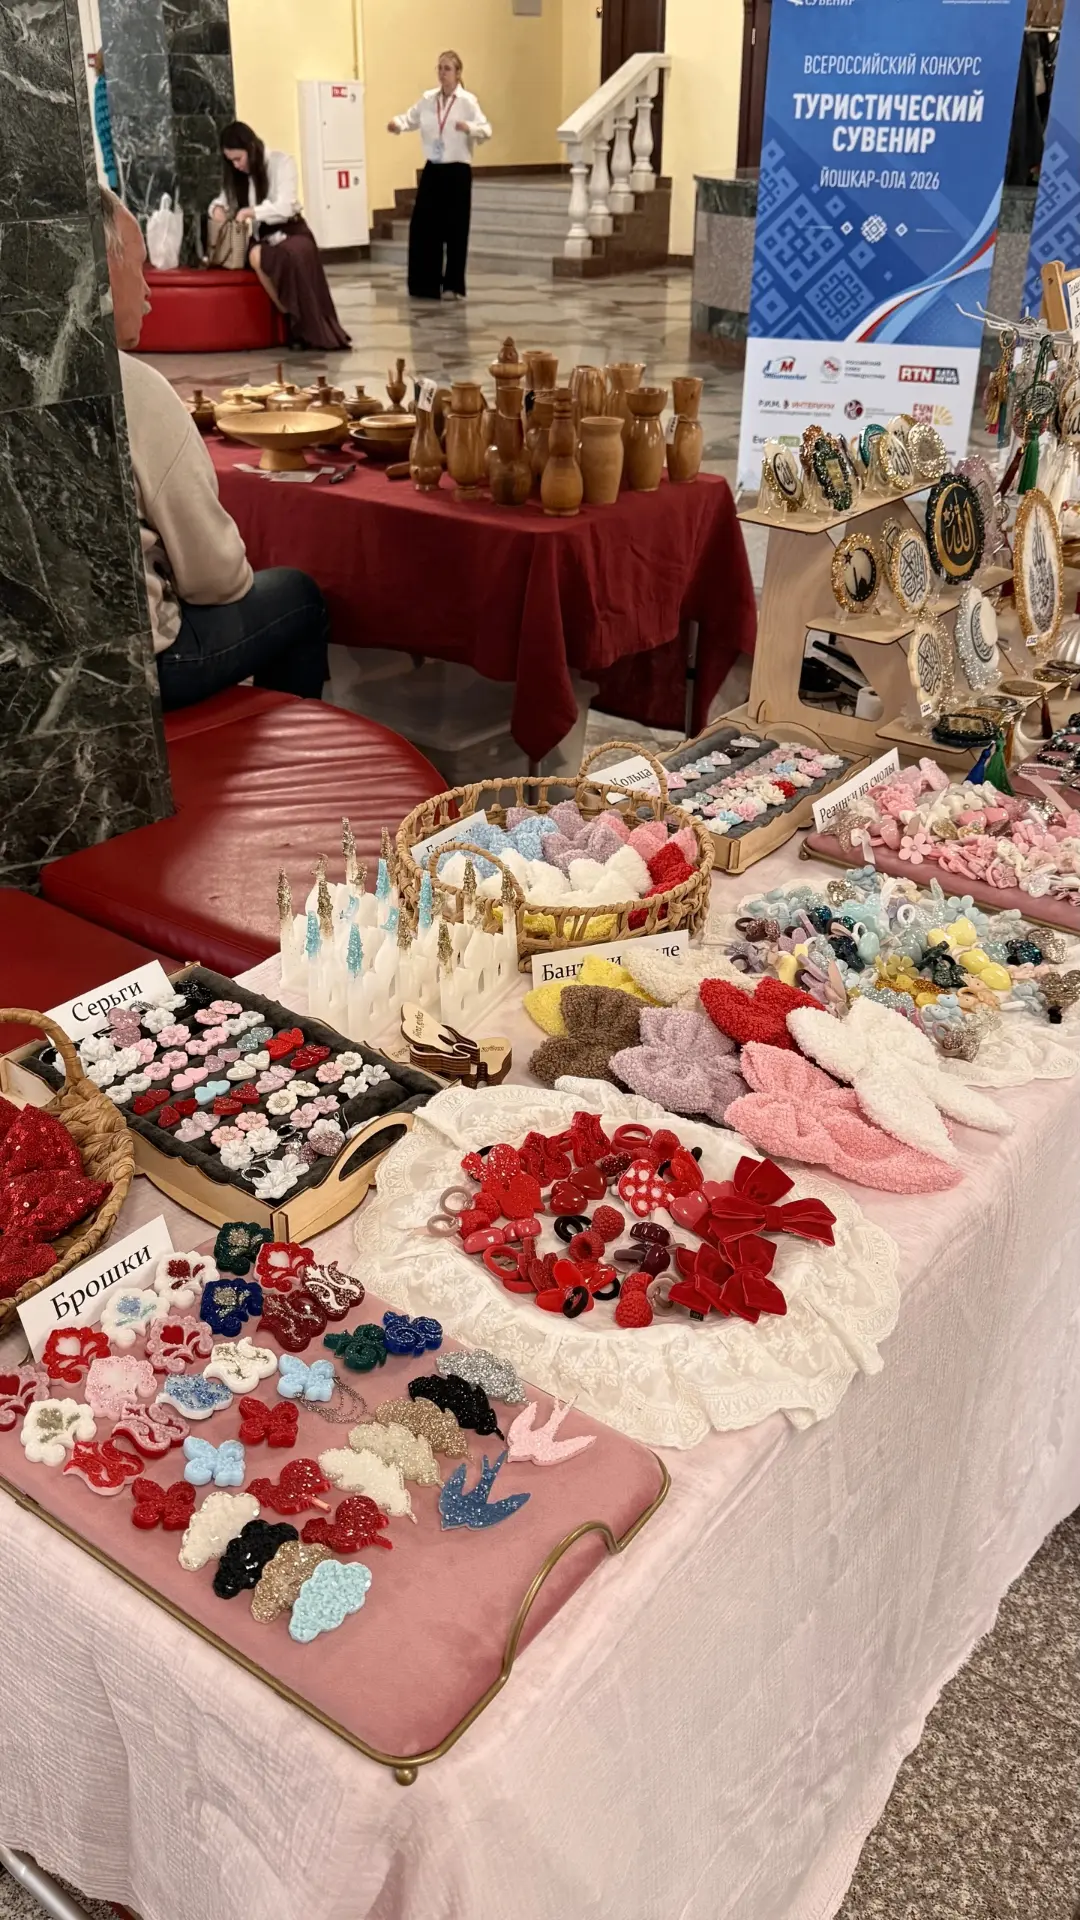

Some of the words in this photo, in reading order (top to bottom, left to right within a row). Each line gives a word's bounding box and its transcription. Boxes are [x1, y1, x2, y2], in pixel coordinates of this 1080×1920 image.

[804, 53, 916, 75] ВСЕРОССИЙСКИЙ
[920, 56, 982, 76] КОНКУРС
[793, 89, 984, 123] ТУРИСТИЧЕСКИЙ
[832, 125, 936, 154] СУВЕНИР
[820, 166, 906, 189] ЙОШКАР-ОЛА
[910, 171, 940, 190] 2026
[901, 367, 933, 381] RTN
[609, 768, 653, 788] Кольца
[858, 782, 870, 797] из
[869, 762, 896, 788] смолы
[71, 981, 143, 1022] Серьги
[50, 1244, 152, 1321] Брошки
